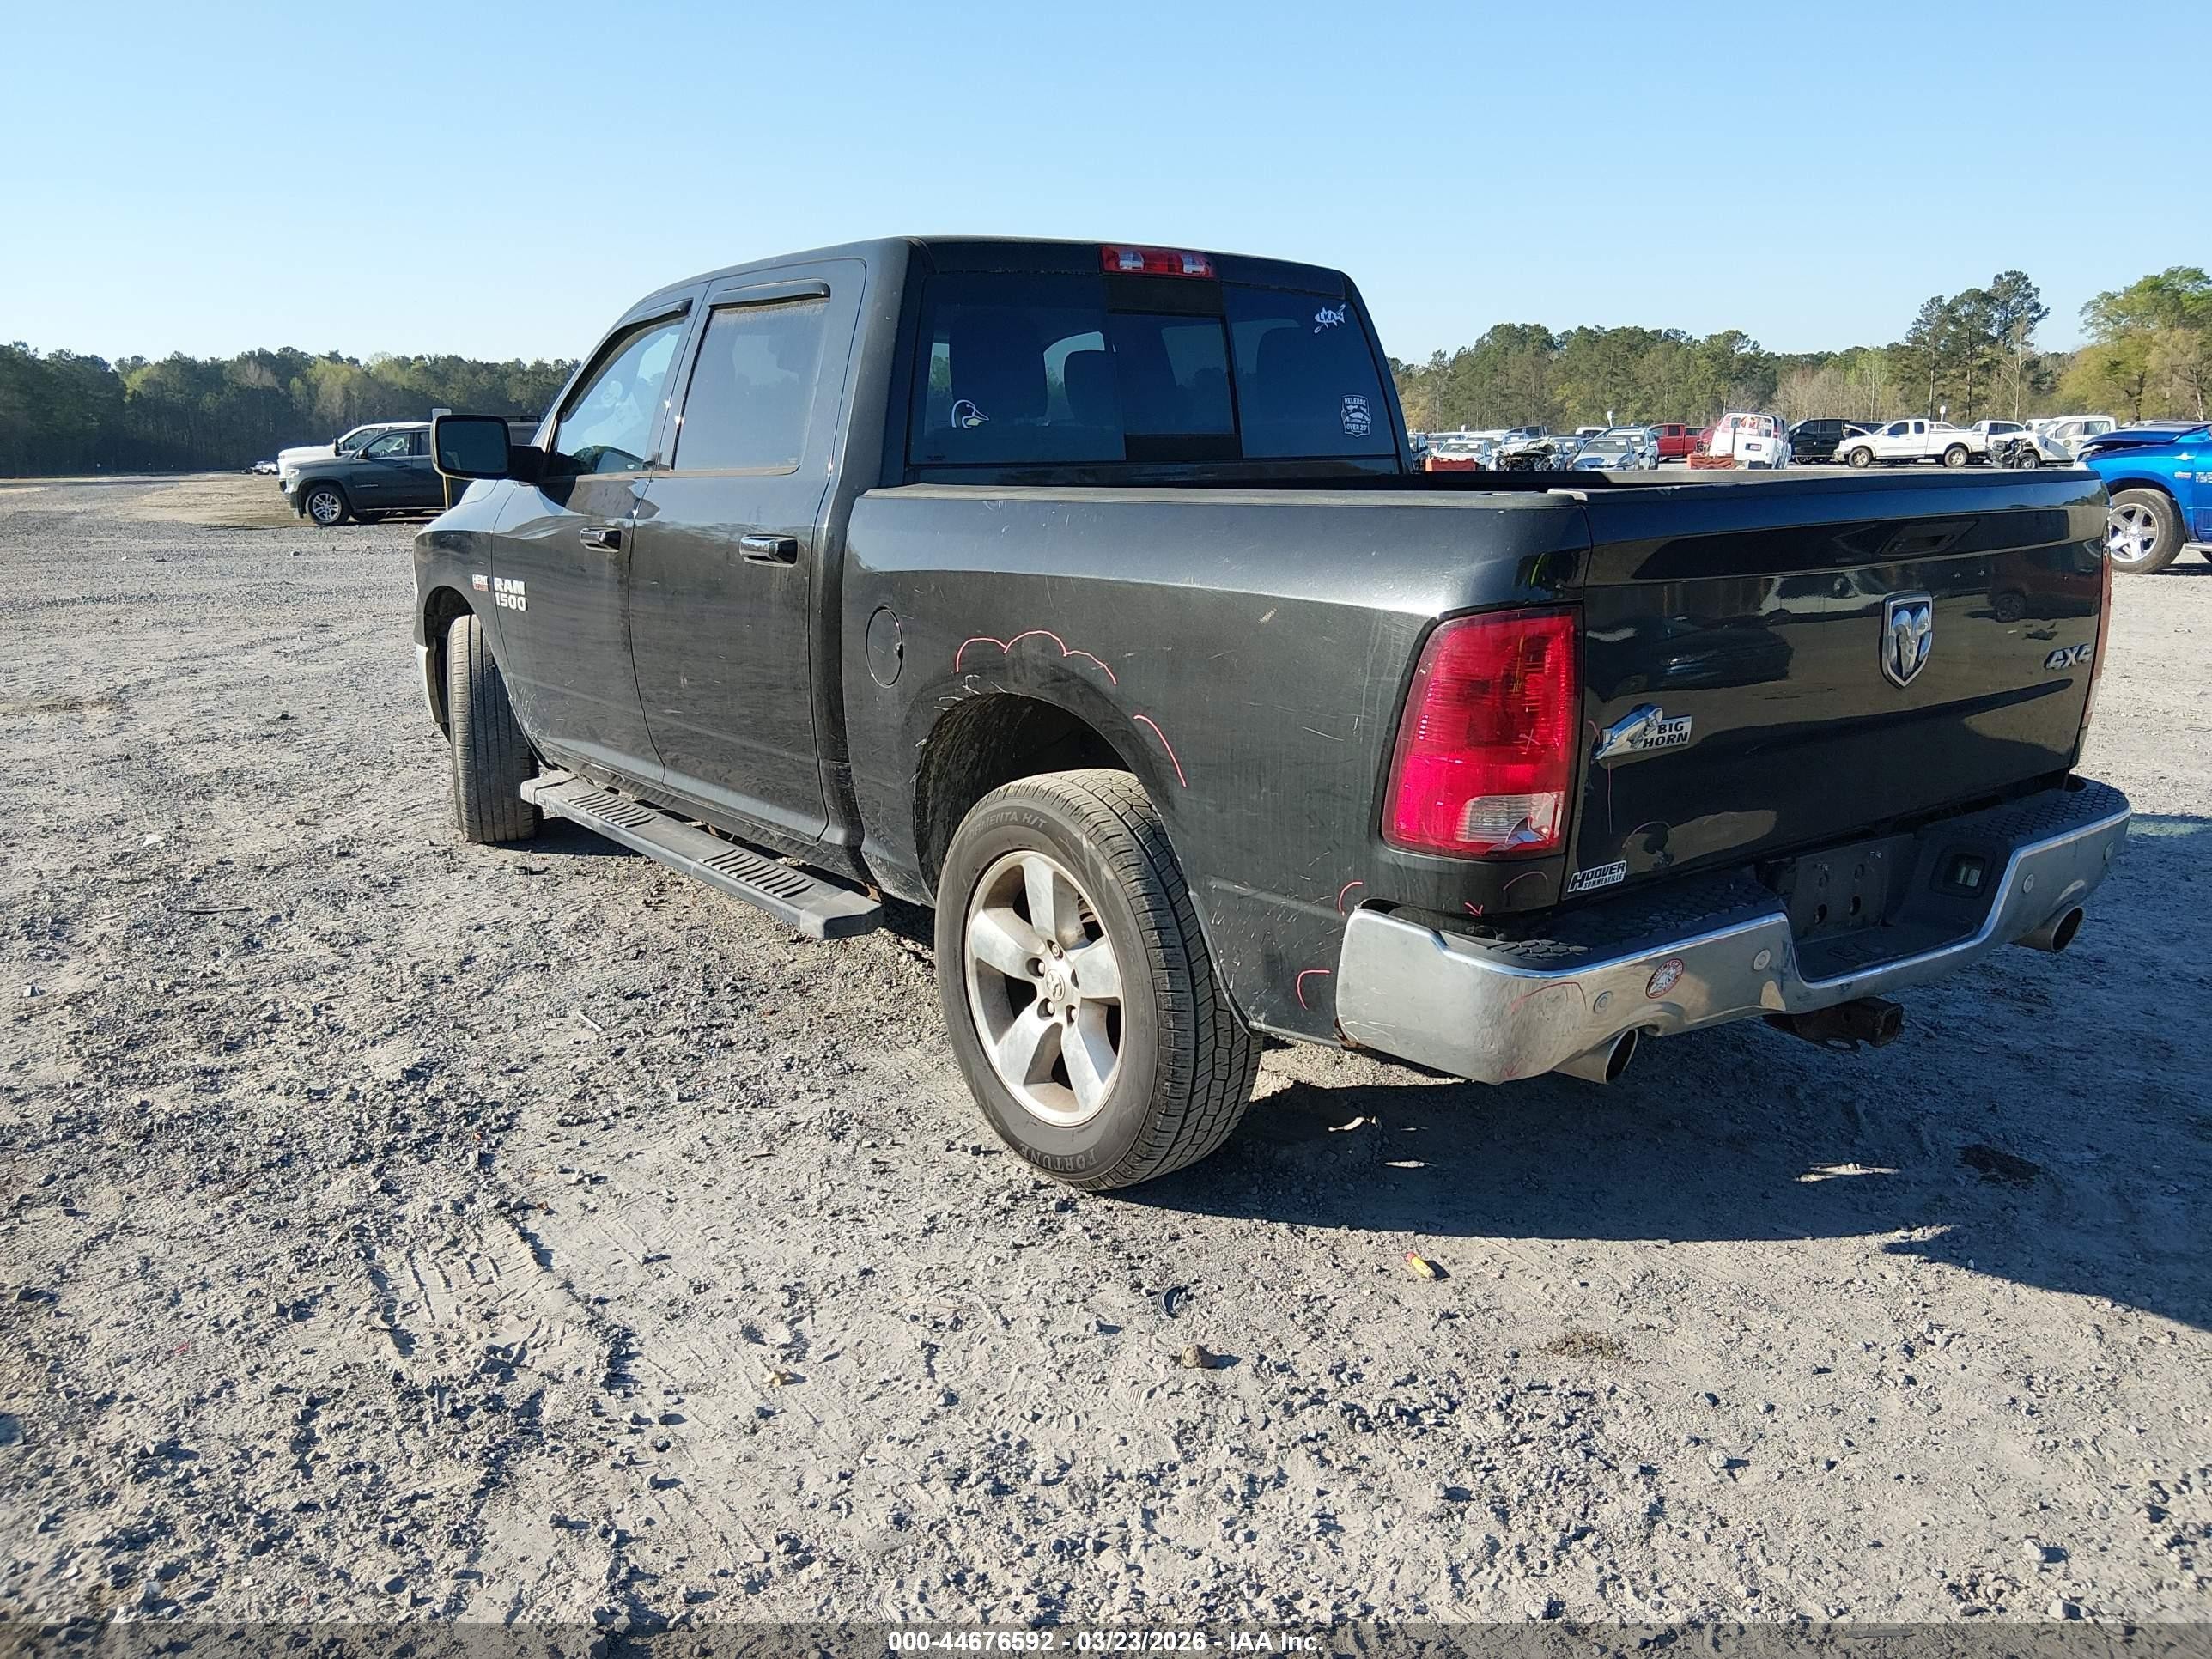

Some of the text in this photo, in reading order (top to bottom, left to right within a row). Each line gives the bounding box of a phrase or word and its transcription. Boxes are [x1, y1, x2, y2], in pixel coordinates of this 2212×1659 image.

[472, 574, 488, 585] HEMI
[494, 577, 525, 595] RAM
[495, 592, 526, 611] 1500
[1657, 721, 1684, 735] BIG
[1643, 732, 1689, 749] HORN
[1023, 812, 1048, 829] H/T
[1570, 862, 1626, 890] HOOVER
[1019, 1144, 1098, 1171] FORTUNE
